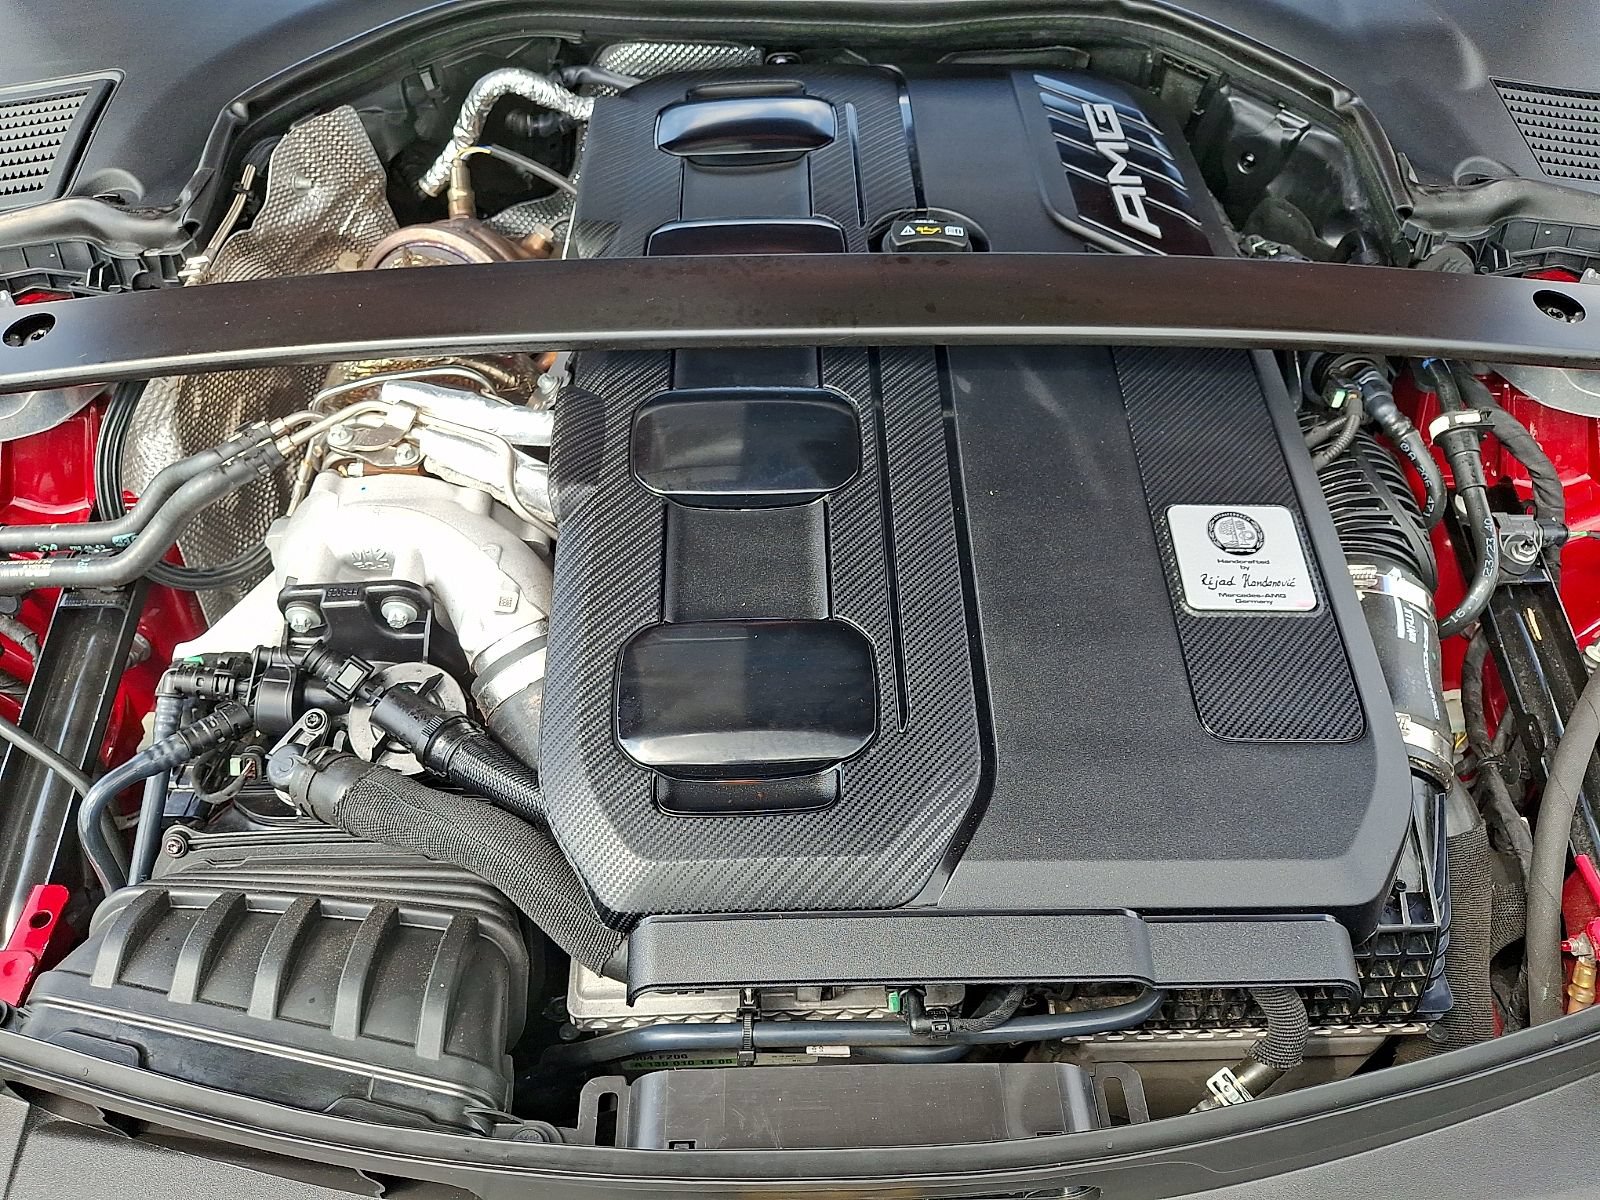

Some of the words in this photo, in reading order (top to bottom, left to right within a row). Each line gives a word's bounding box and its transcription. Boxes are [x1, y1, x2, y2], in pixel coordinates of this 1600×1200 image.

[1081, 103, 1162, 239] AMG
[1416, 465, 1433, 488] 206
[1200, 573, 1237, 590] Rijad
[1235, 598, 1274, 606] Germany
